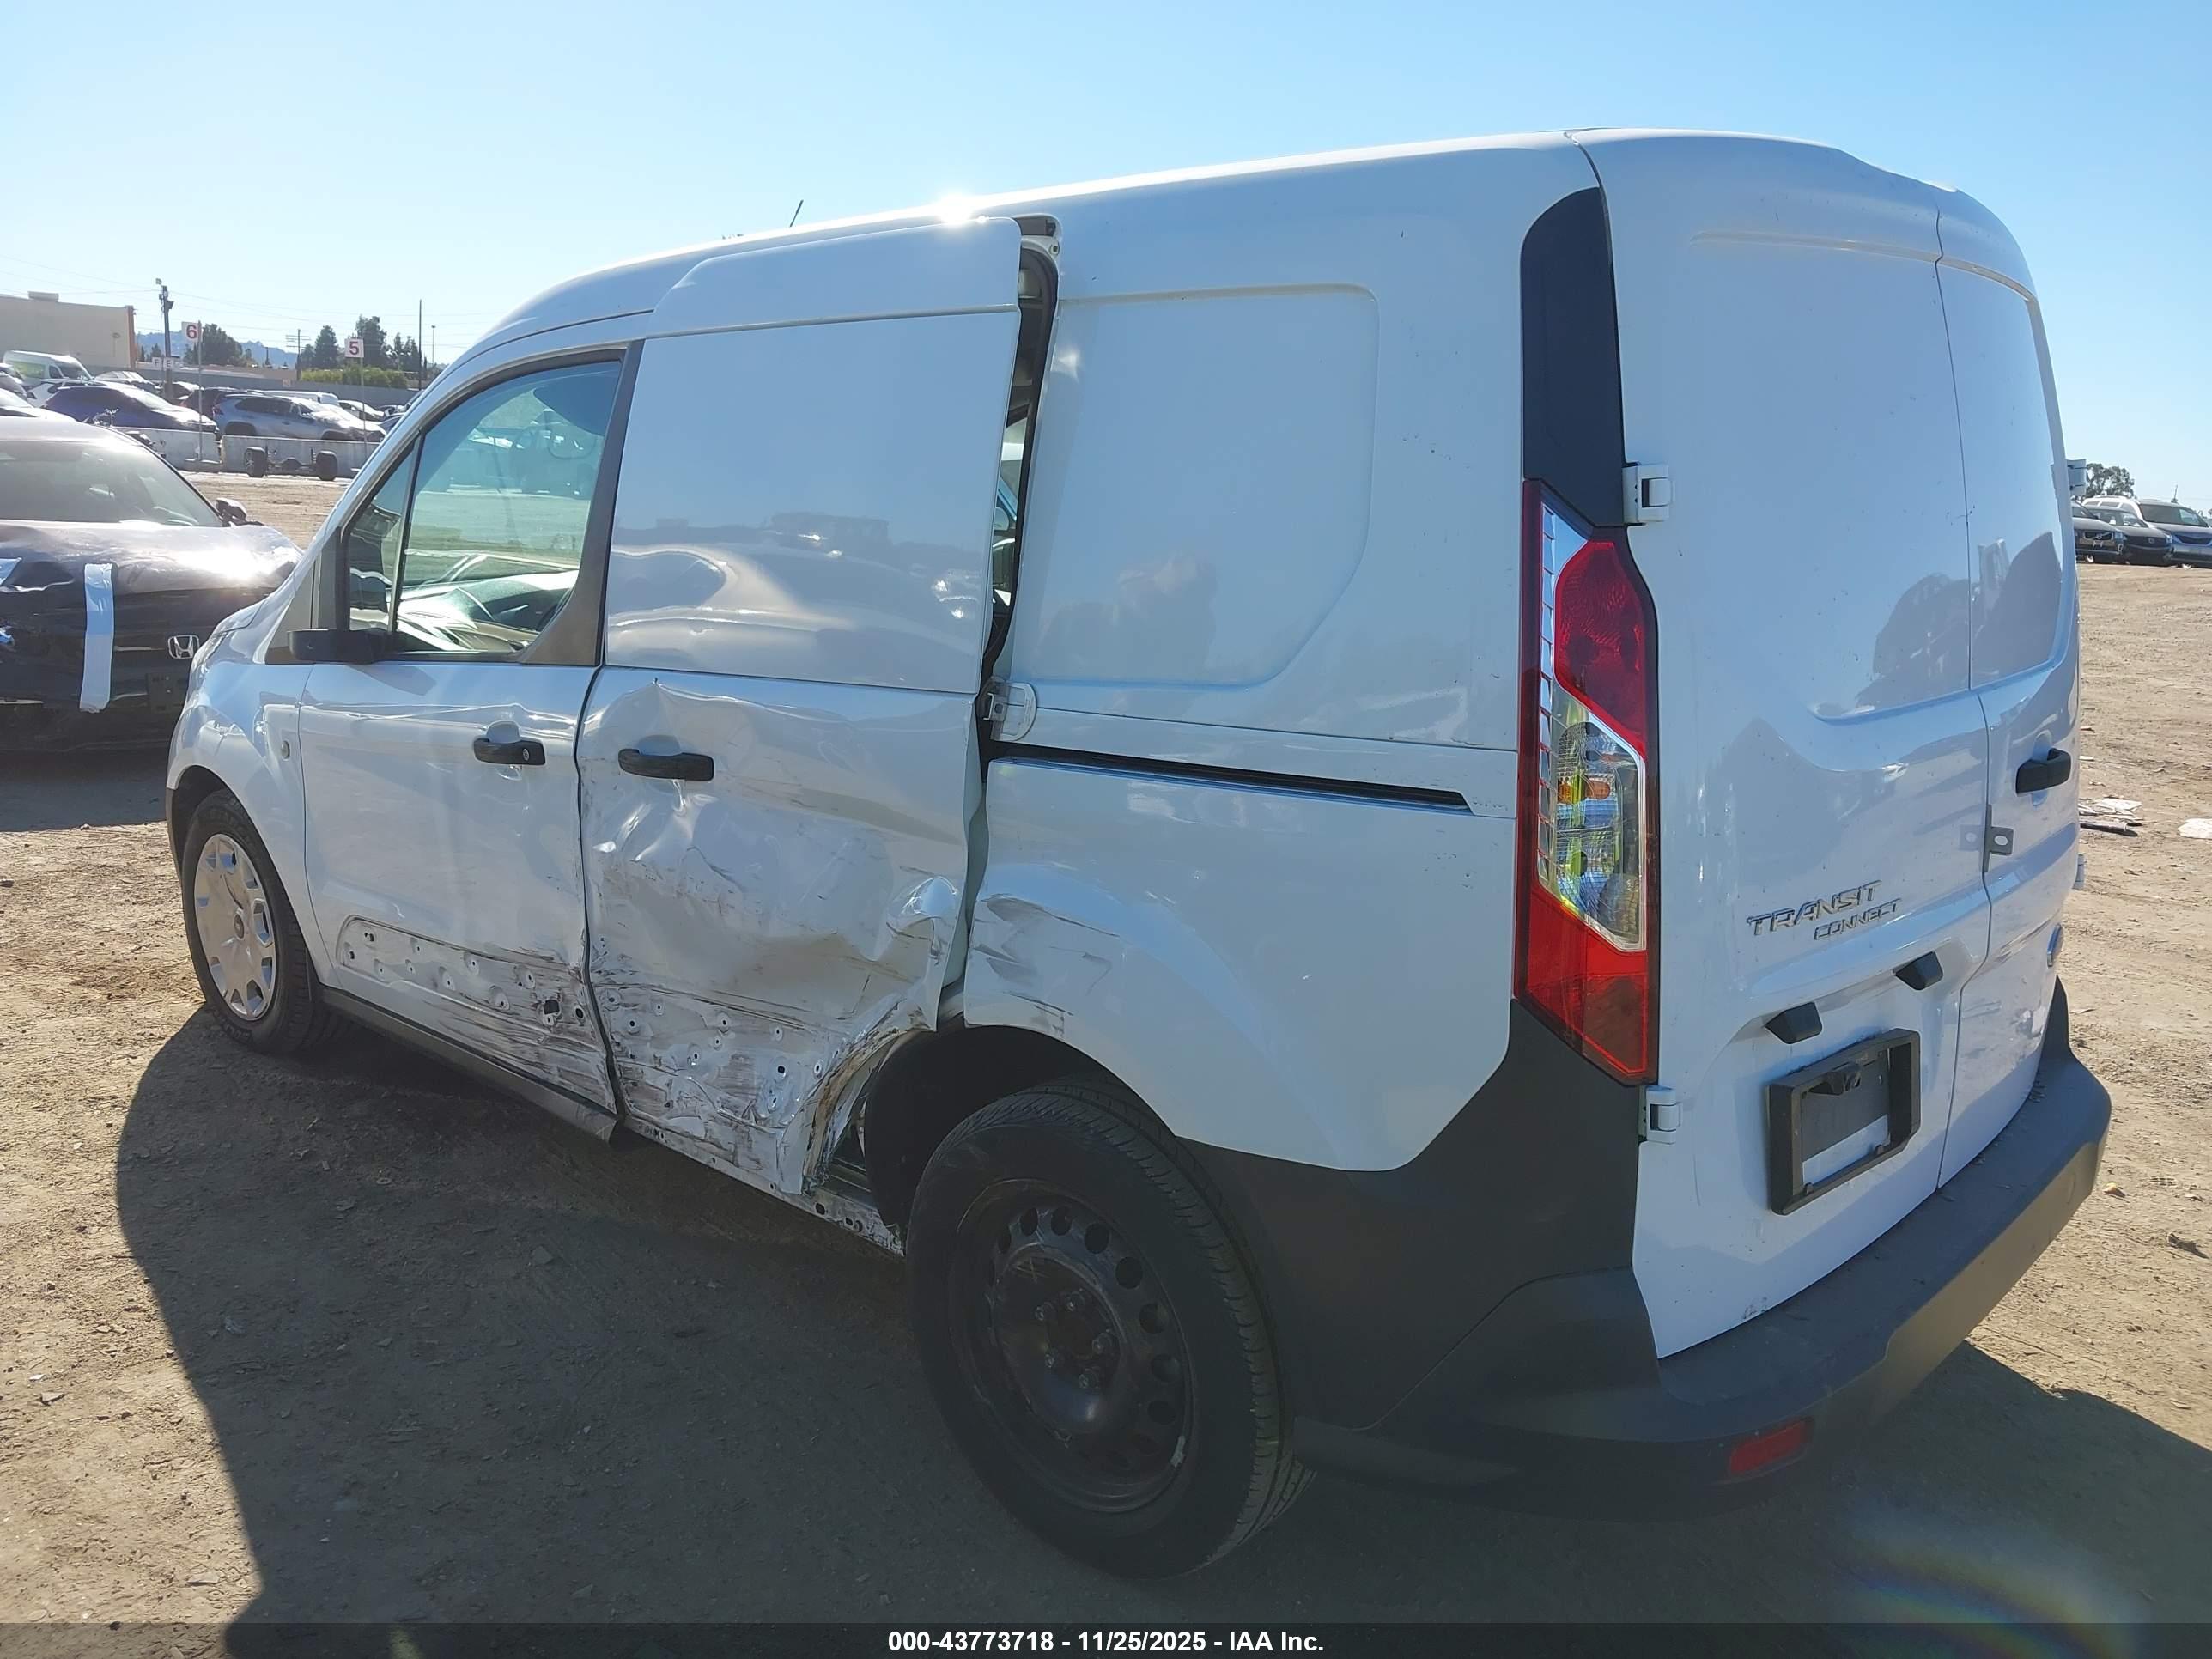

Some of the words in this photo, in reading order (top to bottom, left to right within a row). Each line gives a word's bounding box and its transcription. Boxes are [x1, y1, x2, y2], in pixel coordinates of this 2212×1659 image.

[186, 325, 198, 339] 6
[349, 341, 359, 355] 5
[1747, 879, 1883, 936] TRANSIT
[1813, 897, 1902, 940] CONNECT
